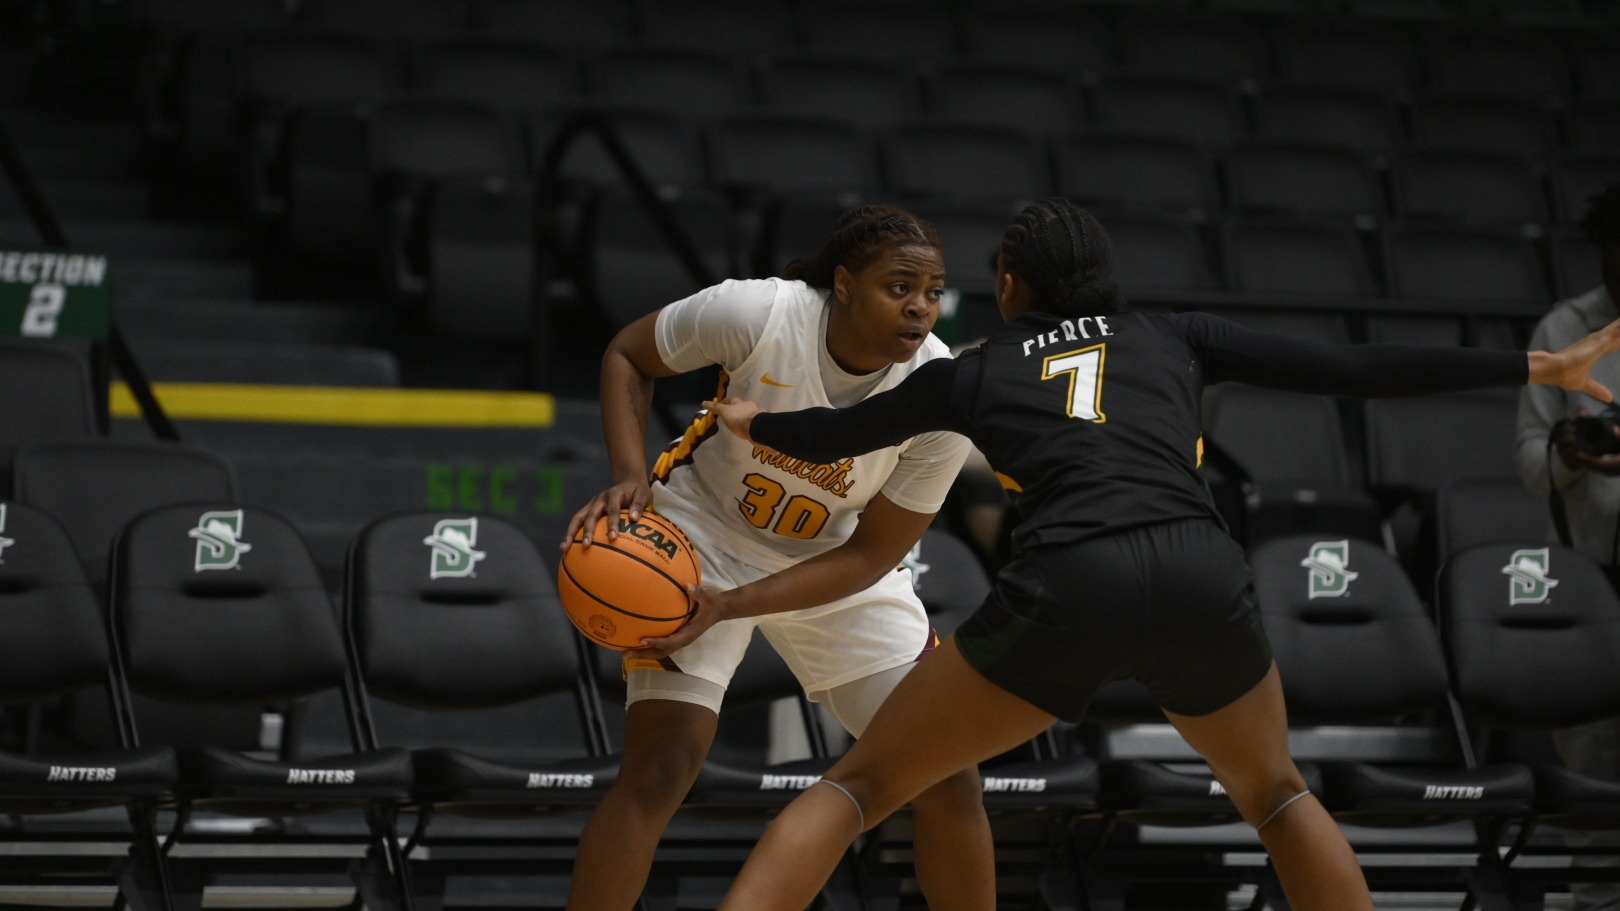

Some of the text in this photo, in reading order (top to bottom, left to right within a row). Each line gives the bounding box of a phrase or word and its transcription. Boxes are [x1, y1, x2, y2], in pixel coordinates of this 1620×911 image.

[0, 250, 108, 288] ECTION
[20, 281, 67, 339] 2
[1022, 315, 1114, 357] PIERCE
[1041, 342, 1107, 424] 7
[426, 462, 519, 516] SEC
[738, 473, 831, 540] 30
[618, 517, 678, 560] NCAA
[47, 765, 117, 783] HATTERS
[287, 768, 356, 785] HATTERS
[525, 772, 595, 789] HATTERS
[983, 776, 1047, 793] HATTERS
[1423, 784, 1485, 801] HATTERS
